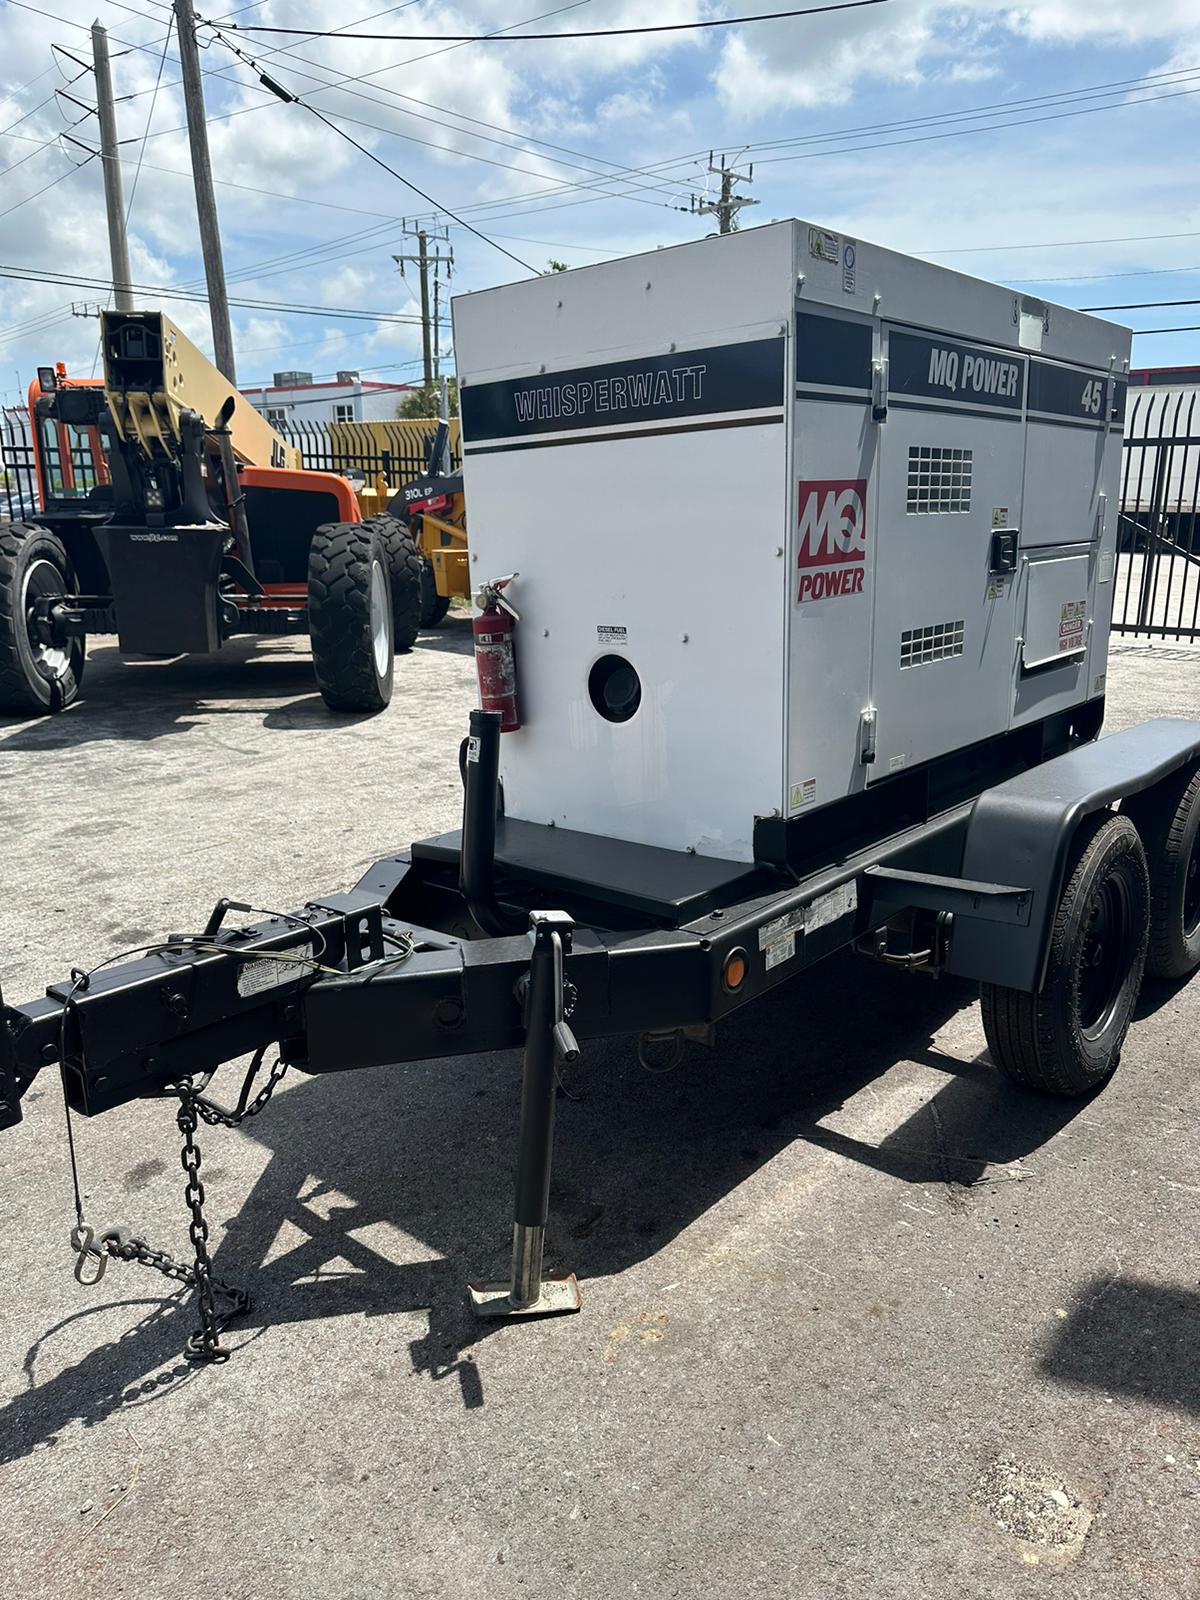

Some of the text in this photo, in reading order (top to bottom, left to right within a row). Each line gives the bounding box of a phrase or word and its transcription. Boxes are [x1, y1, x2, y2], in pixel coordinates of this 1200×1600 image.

[928, 348, 1019, 397] MQ POWER
[514, 365, 706, 422] WHISPERWATT
[1081, 380, 1103, 414] 45
[270, 438, 286, 469] JLG
[404, 487, 433, 501] 310L EP
[798, 488, 866, 557] MQ
[797, 567, 865, 602] POWER
